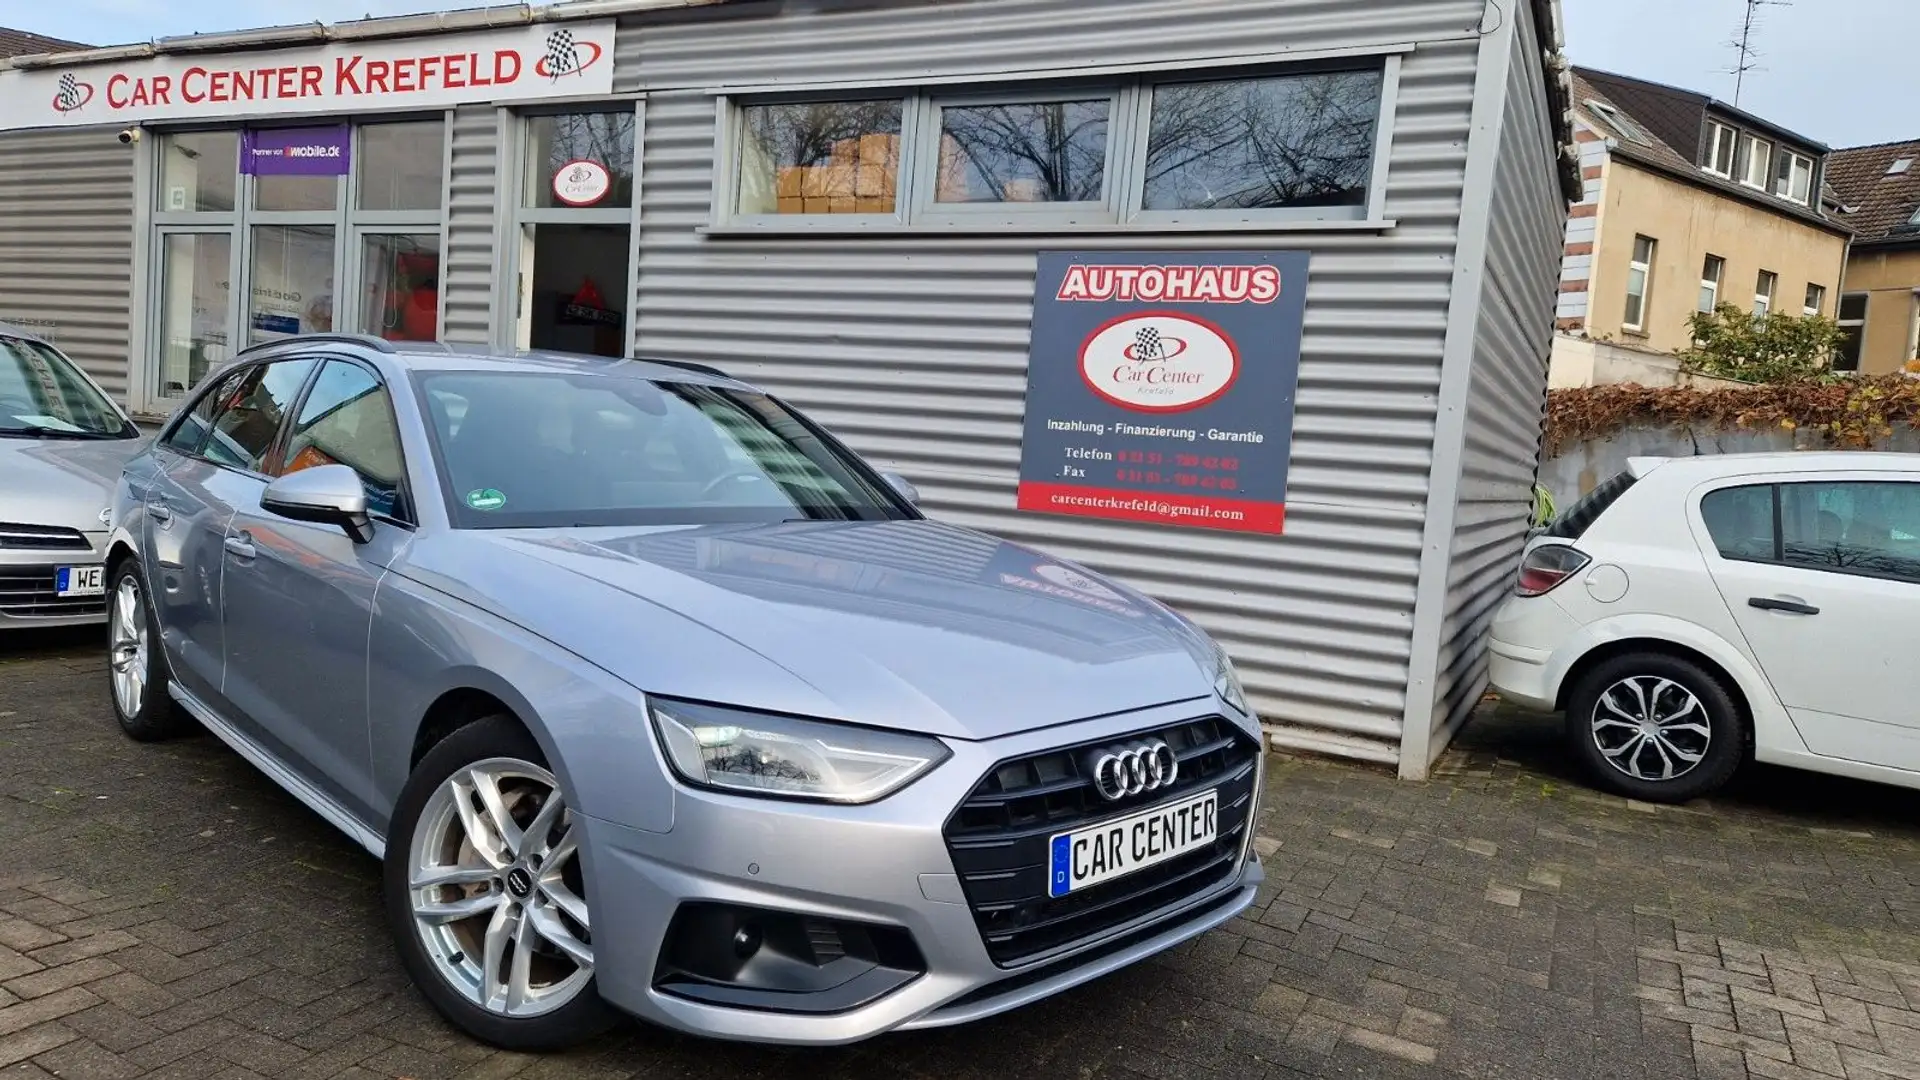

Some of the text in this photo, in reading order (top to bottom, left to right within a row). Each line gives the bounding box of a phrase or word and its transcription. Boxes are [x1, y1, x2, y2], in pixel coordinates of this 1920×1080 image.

[107, 49, 522, 109] CAR CENTER KREFELD
[1056, 264, 1281, 304] AUTOHAUS
[1113, 365, 1205, 384] Car Center
[1047, 419, 1105, 436] Inzahlung
[1115, 422, 1197, 441] Finanzierung
[1207, 428, 1264, 443] Garantie
[1065, 447, 1113, 461] Telefon
[1063, 465, 1087, 478] Fax
[1051, 494, 1244, 520] carcenterkrefeld@gmail.com
[1073, 827, 1124, 881] CAR
[1131, 798, 1215, 863] CENTER
